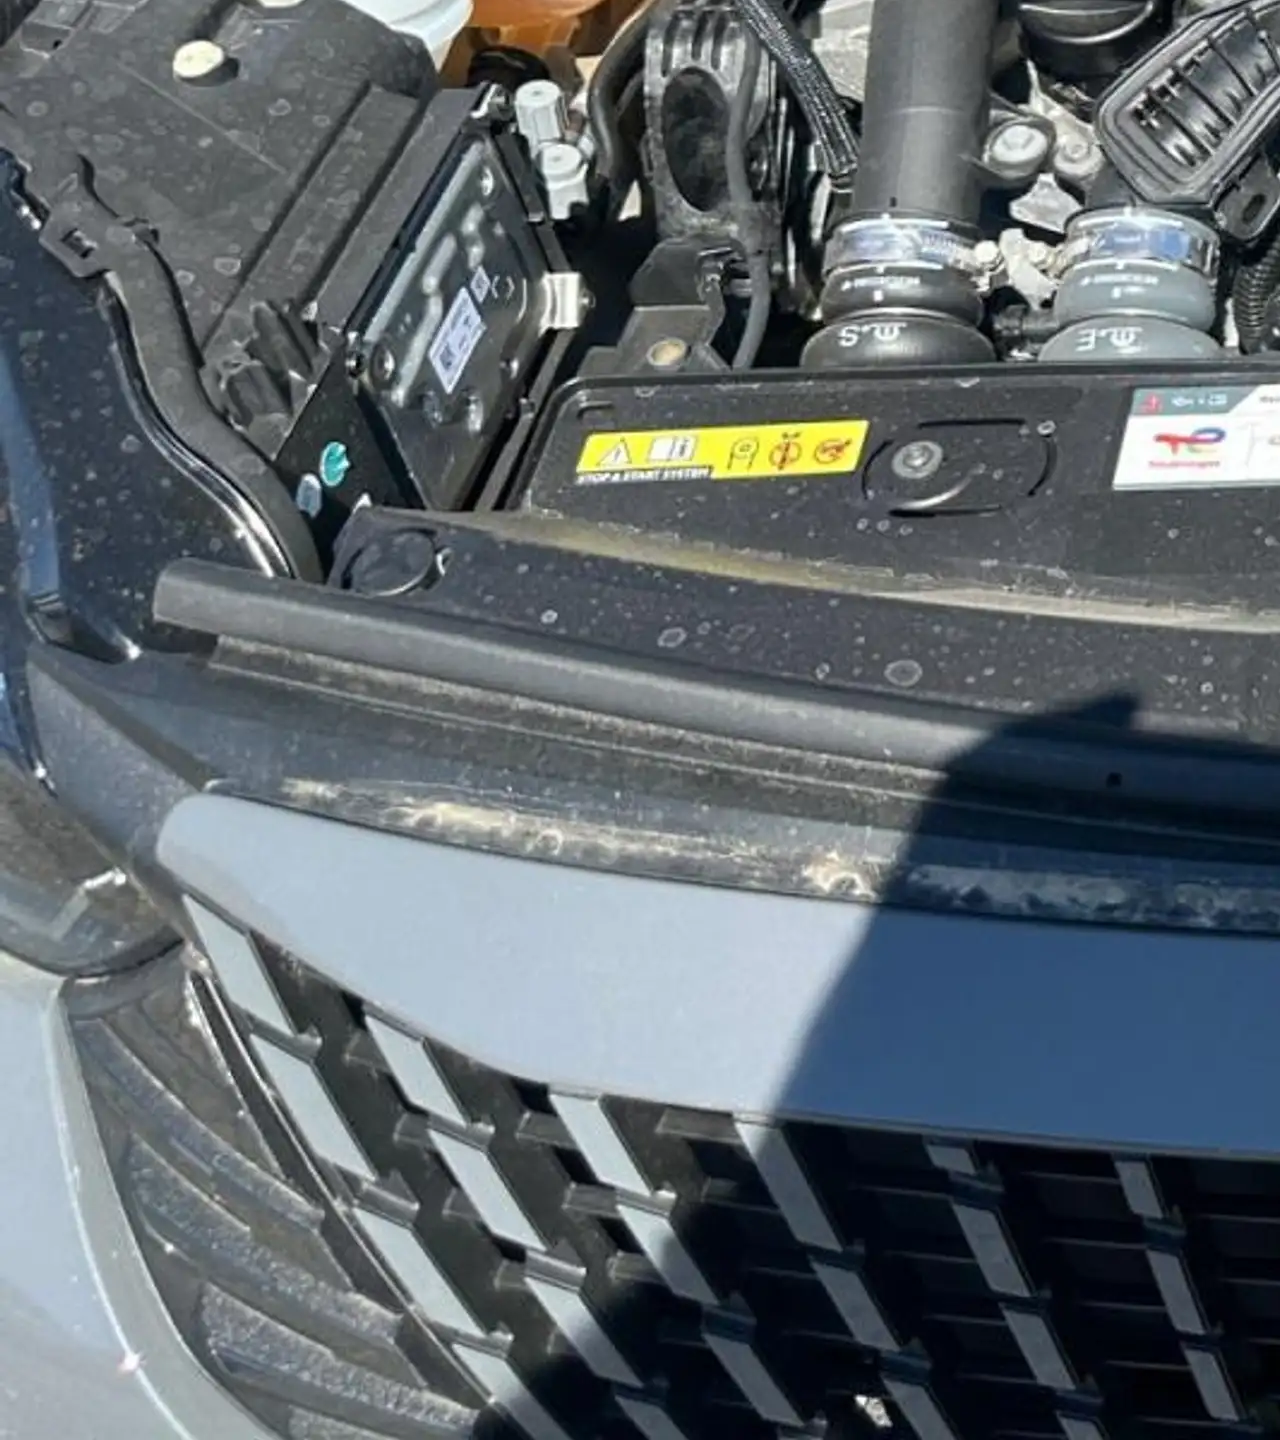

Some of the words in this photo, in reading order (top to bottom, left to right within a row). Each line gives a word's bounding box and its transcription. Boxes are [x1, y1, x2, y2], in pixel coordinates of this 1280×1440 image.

[577, 471, 608, 485] STOP
[623, 469, 656, 481] START
[660, 467, 710, 480] SYSTEM
